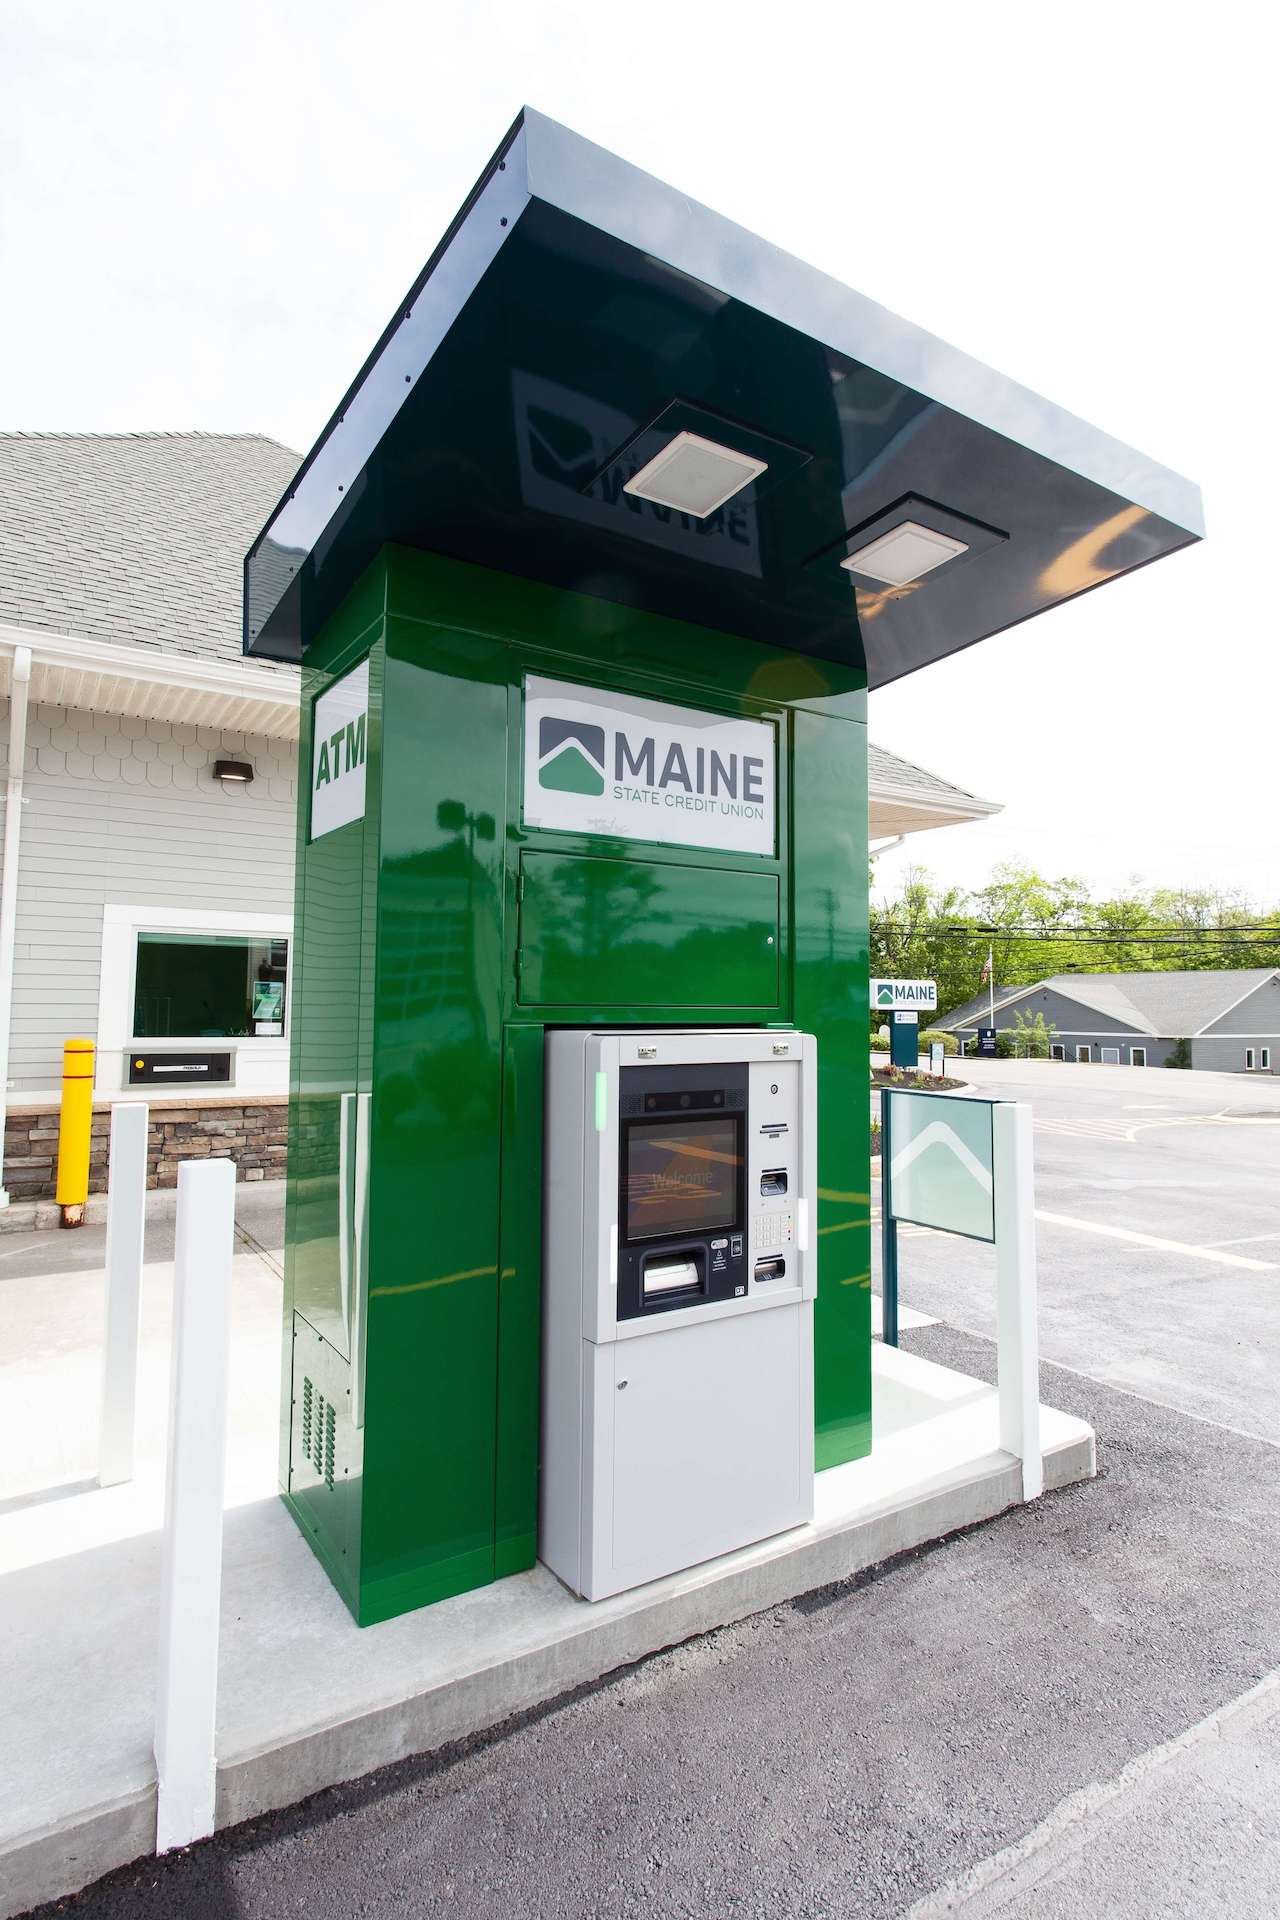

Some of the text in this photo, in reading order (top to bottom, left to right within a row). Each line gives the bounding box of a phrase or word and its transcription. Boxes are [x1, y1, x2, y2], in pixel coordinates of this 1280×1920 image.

[316, 712, 366, 790] ATM
[615, 732, 764, 803] MAINE
[614, 786, 764, 820] STATE CREDIT UNION
[895, 985, 935, 1001] MAINE
